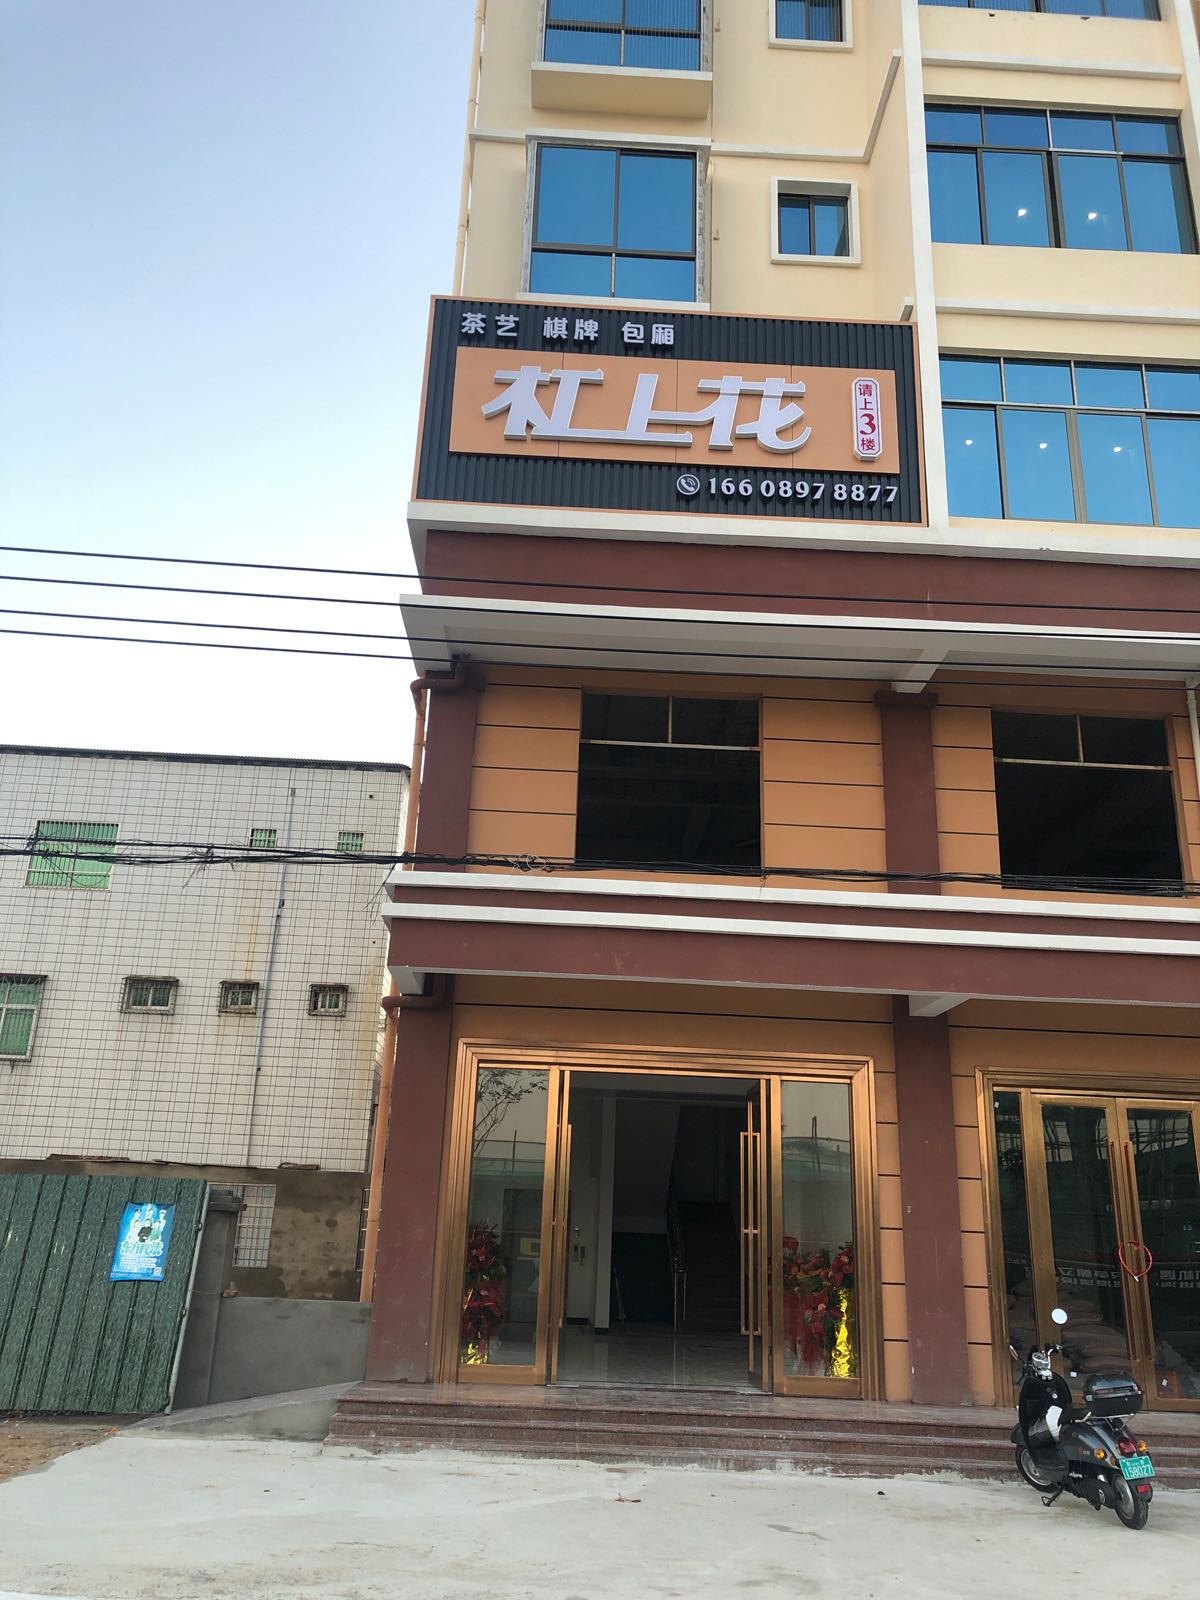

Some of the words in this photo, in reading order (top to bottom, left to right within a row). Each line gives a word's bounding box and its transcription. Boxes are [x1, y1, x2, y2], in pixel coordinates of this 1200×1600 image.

[461, 312, 519, 337] 茶艺
[543, 317, 599, 341] 棋牌
[622, 322, 675, 345] 包厢
[481, 366, 811, 454] 杠上花
[858, 383, 876, 451] 请上3楼
[708, 477, 753, 496] 166
[760, 480, 825, 500] 0897
[833, 483, 898, 502] 8877
